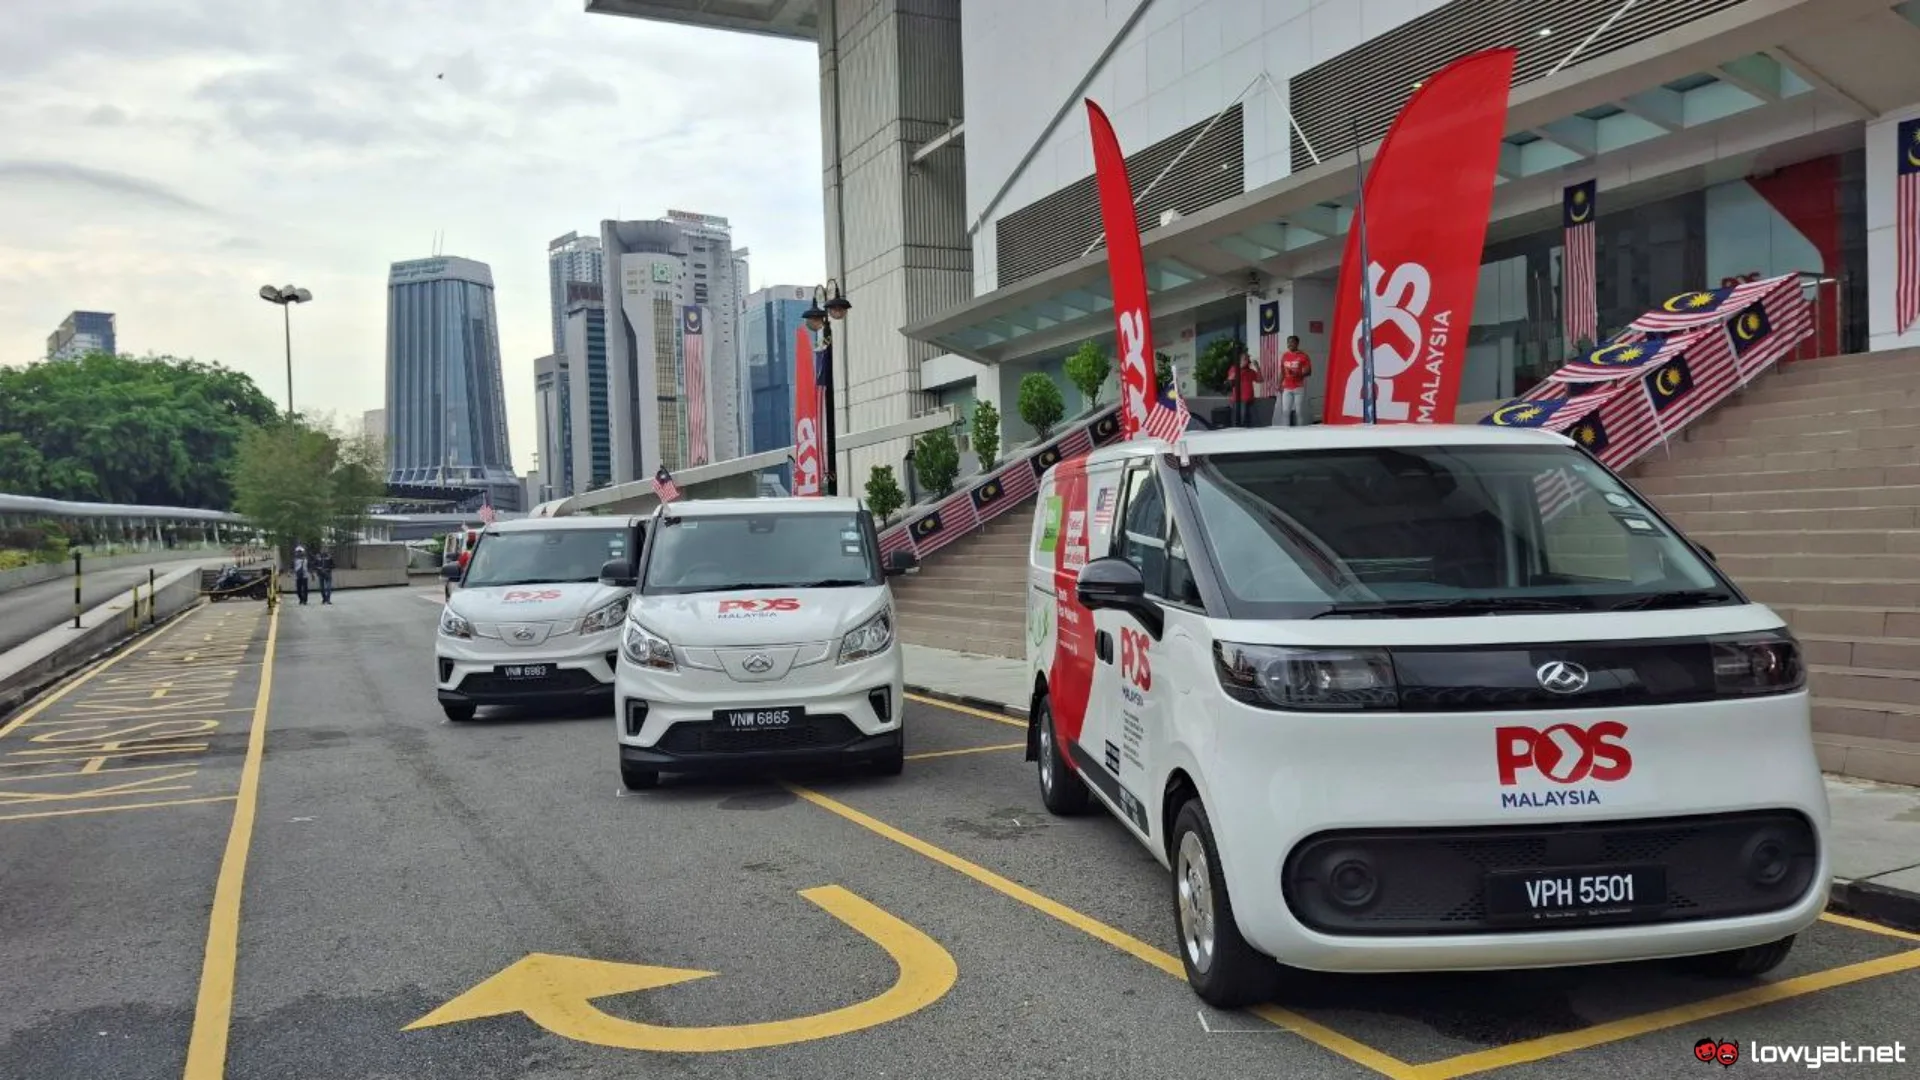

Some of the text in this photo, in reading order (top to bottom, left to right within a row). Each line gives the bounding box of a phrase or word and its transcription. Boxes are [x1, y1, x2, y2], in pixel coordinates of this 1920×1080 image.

[1342, 260, 1431, 420] POS
[1416, 310, 1452, 423] MALAYSIA
[718, 598, 800, 613] POS
[1120, 626, 1151, 691] POS
[756, 710, 790, 725] 6865
[1495, 720, 1632, 785] POS
[1501, 790, 1600, 808] MALAYSIA
[1525, 874, 1633, 908] VPH 5501
